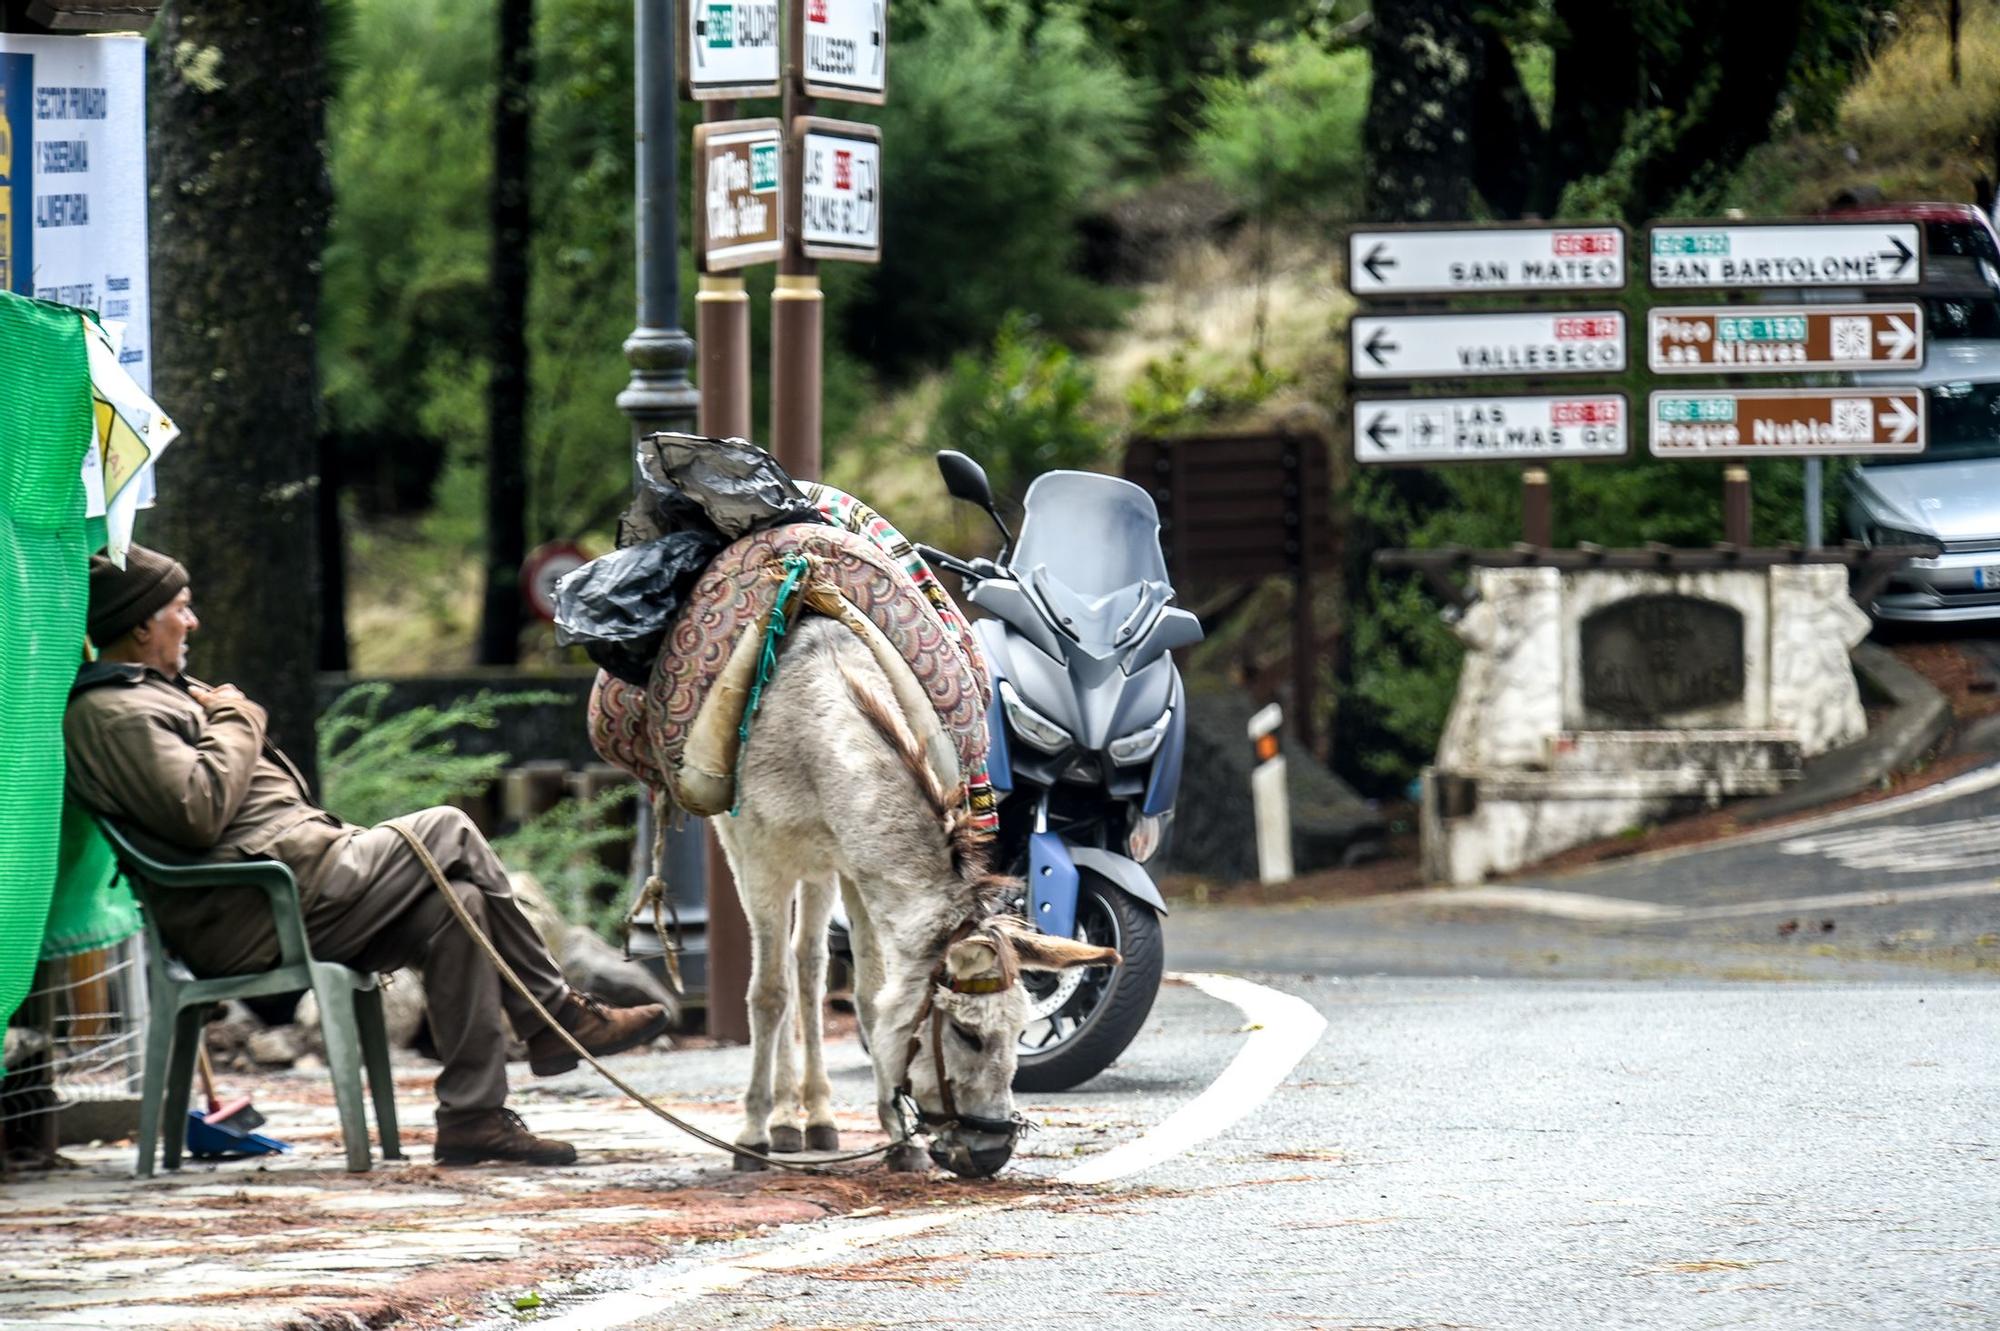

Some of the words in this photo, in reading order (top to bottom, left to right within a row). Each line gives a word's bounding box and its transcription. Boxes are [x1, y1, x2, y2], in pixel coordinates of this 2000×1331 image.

[37, 87, 67, 119] SECTOR
[1449, 262, 1508, 282] SAN
[1521, 259, 1617, 281] MATEO
[1655, 259, 1708, 280] SAN
[1457, 344, 1618, 367] VALLESECO
[1453, 405, 1505, 424] LAS
[1453, 430, 1564, 449] PALMAS
